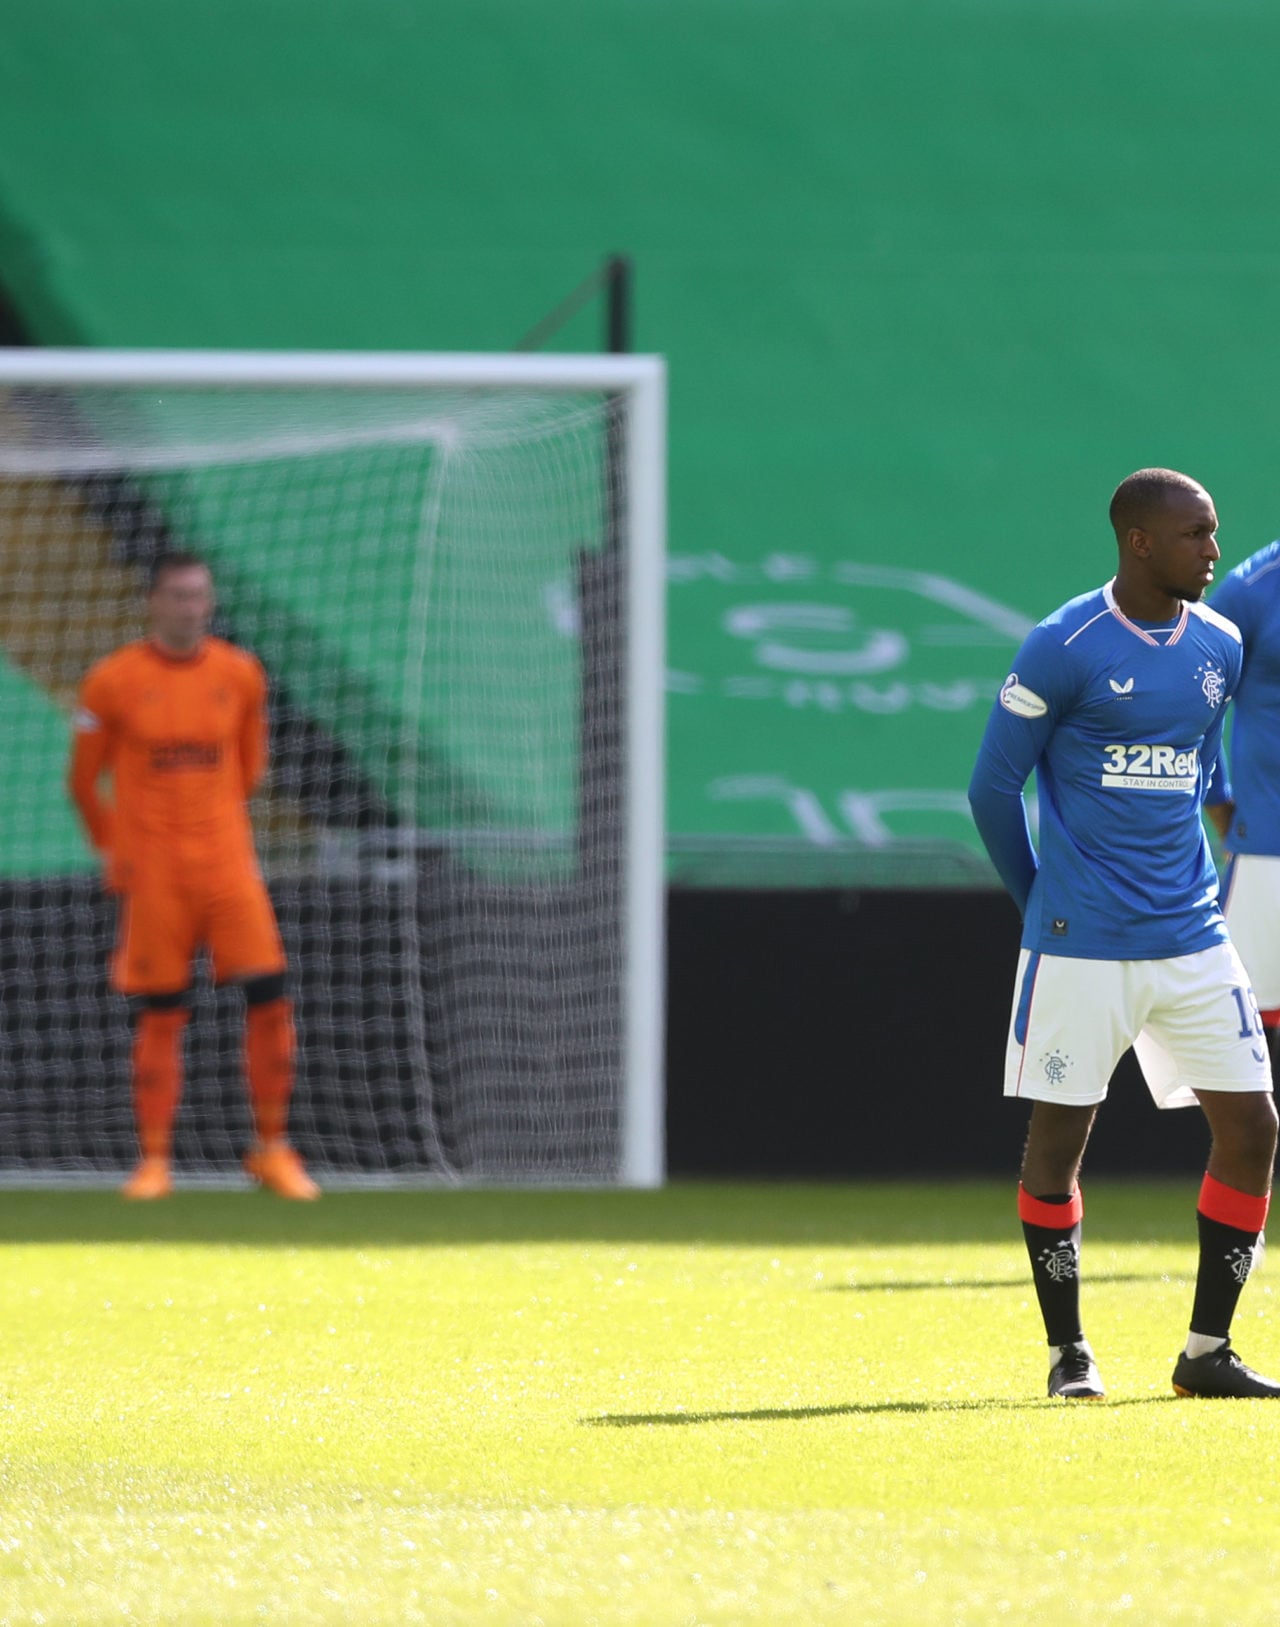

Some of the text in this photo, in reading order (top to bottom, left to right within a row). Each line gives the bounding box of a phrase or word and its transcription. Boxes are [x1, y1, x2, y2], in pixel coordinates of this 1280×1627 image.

[1102, 744, 1198, 776] 32Red
[1122, 778, 1145, 787] STAY
[1146, 779, 1156, 788] IN
